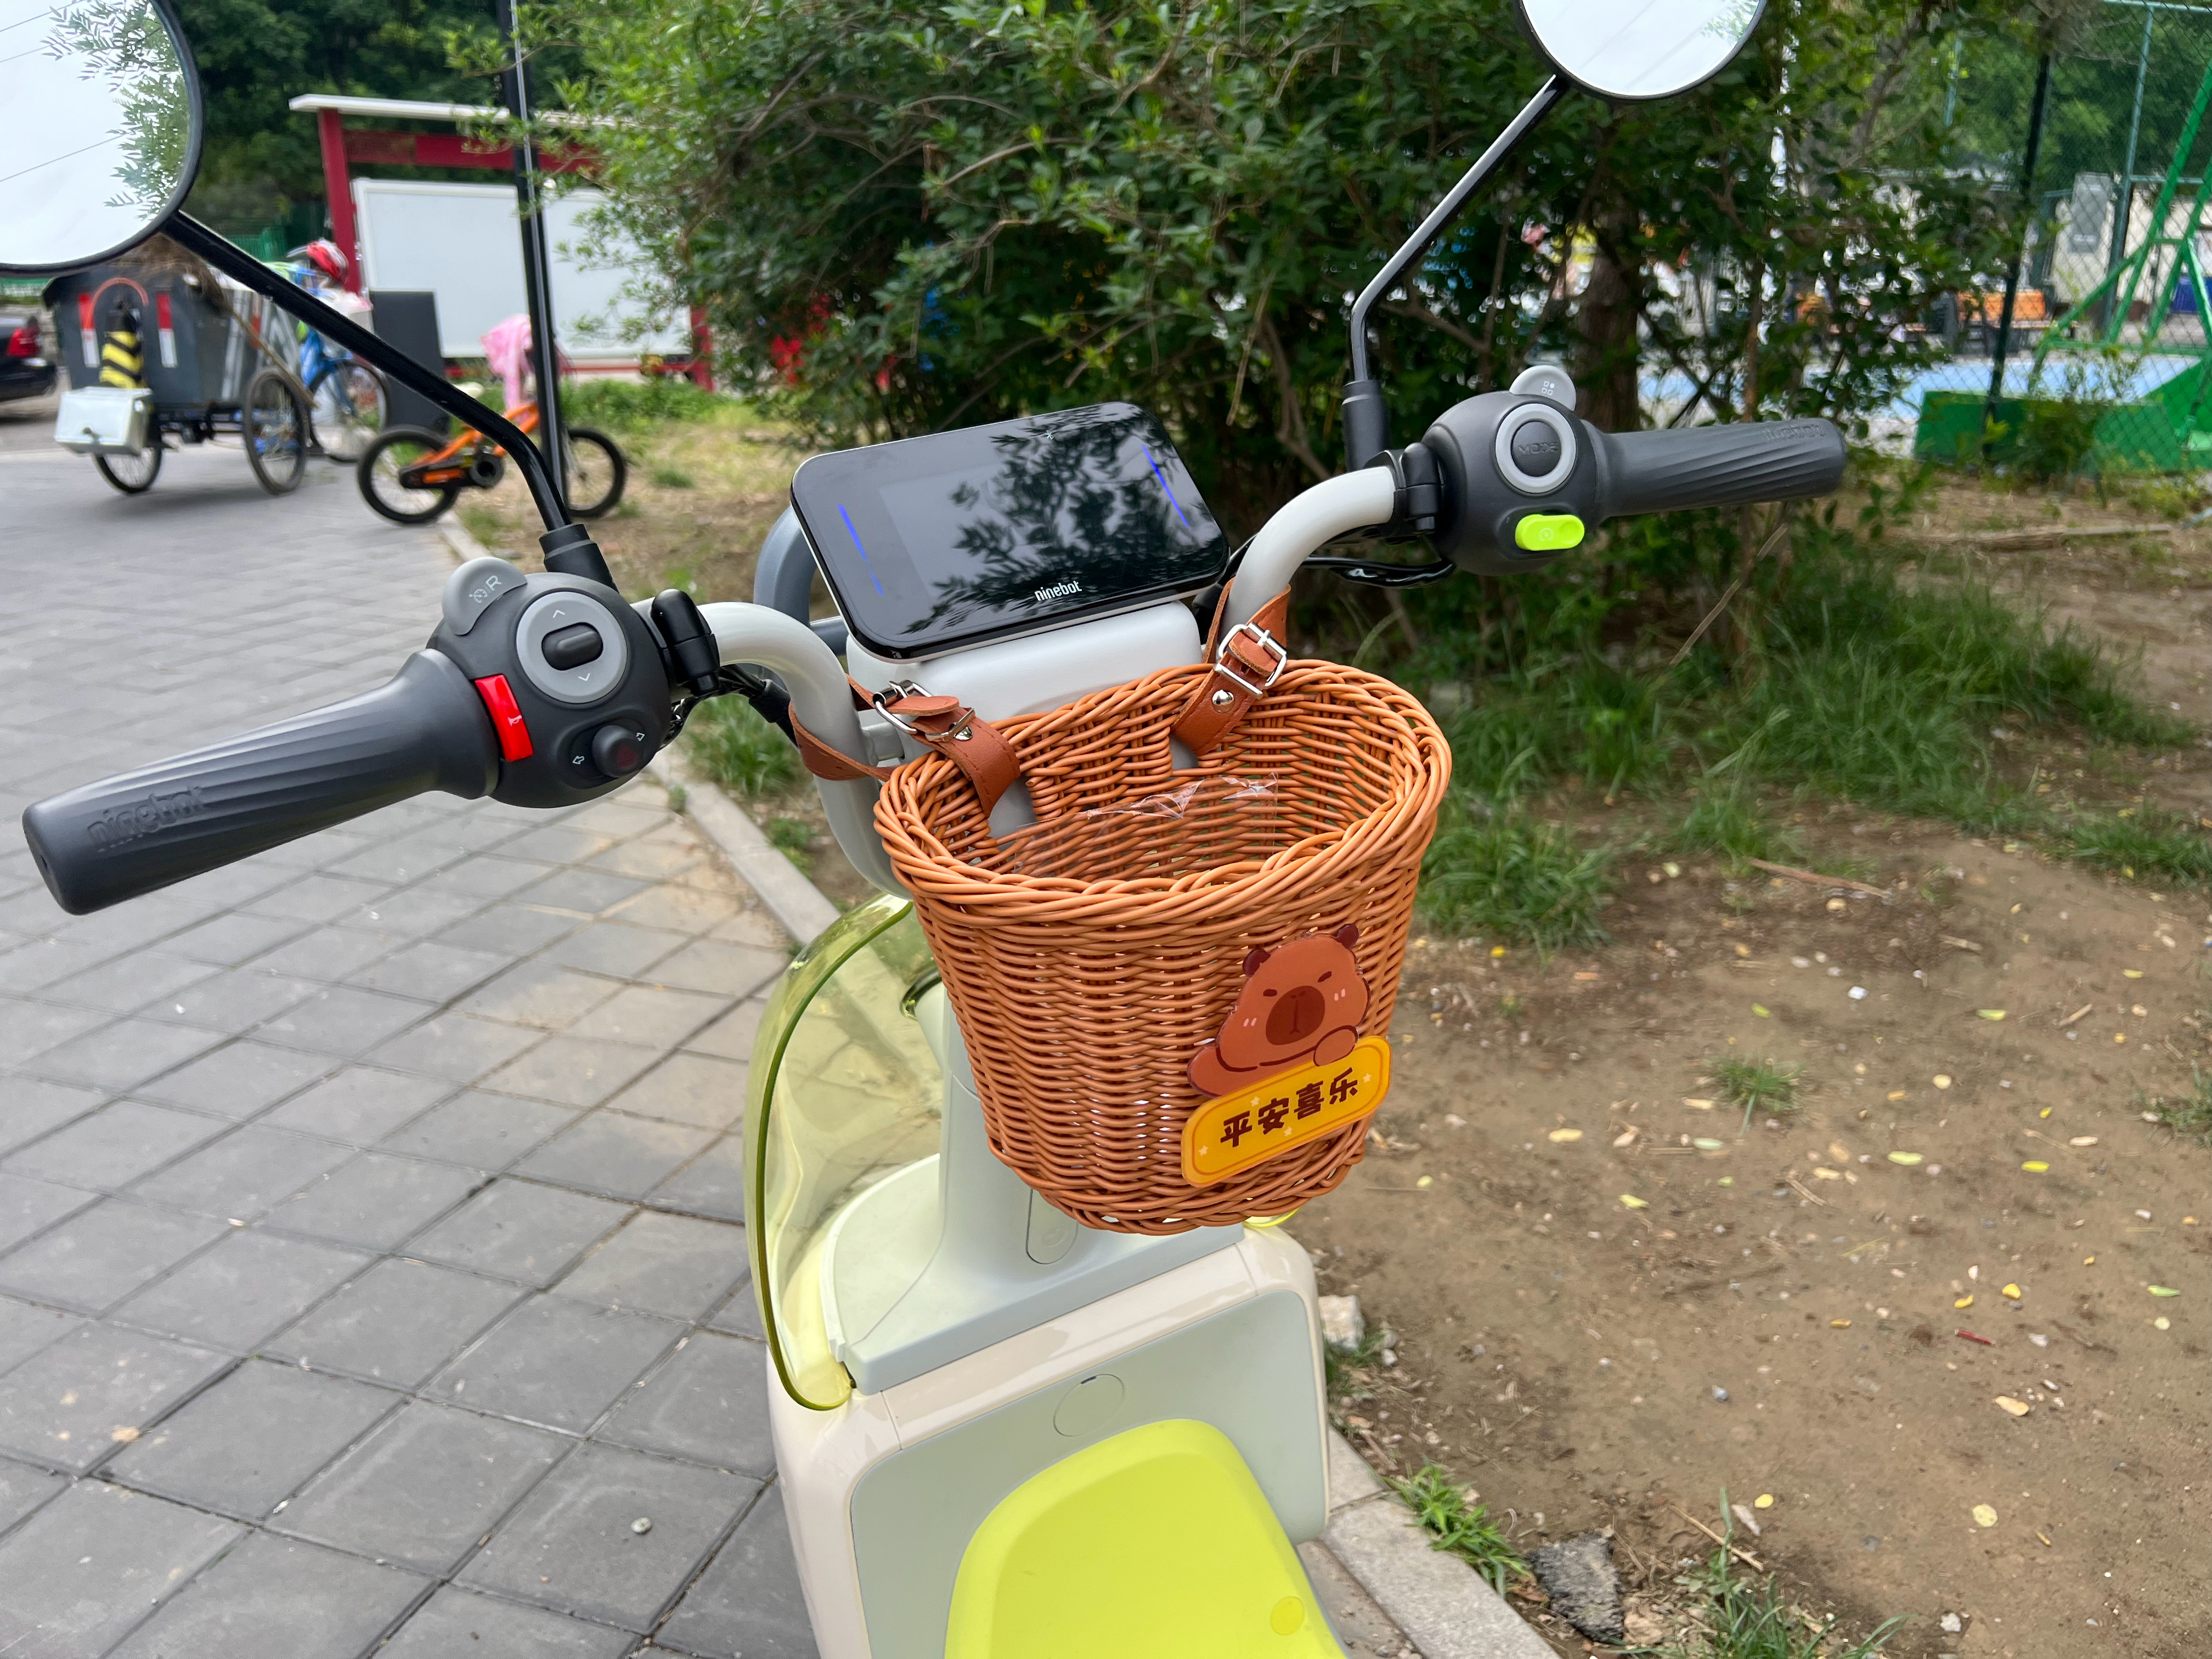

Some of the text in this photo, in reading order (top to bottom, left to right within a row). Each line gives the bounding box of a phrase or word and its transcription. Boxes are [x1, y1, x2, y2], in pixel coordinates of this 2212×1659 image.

[1518, 442, 1558, 455] MODE
[486, 575, 501, 591] R
[1034, 580, 1082, 601] ninebot
[1220, 1067, 1359, 1148] 平安喜乐
